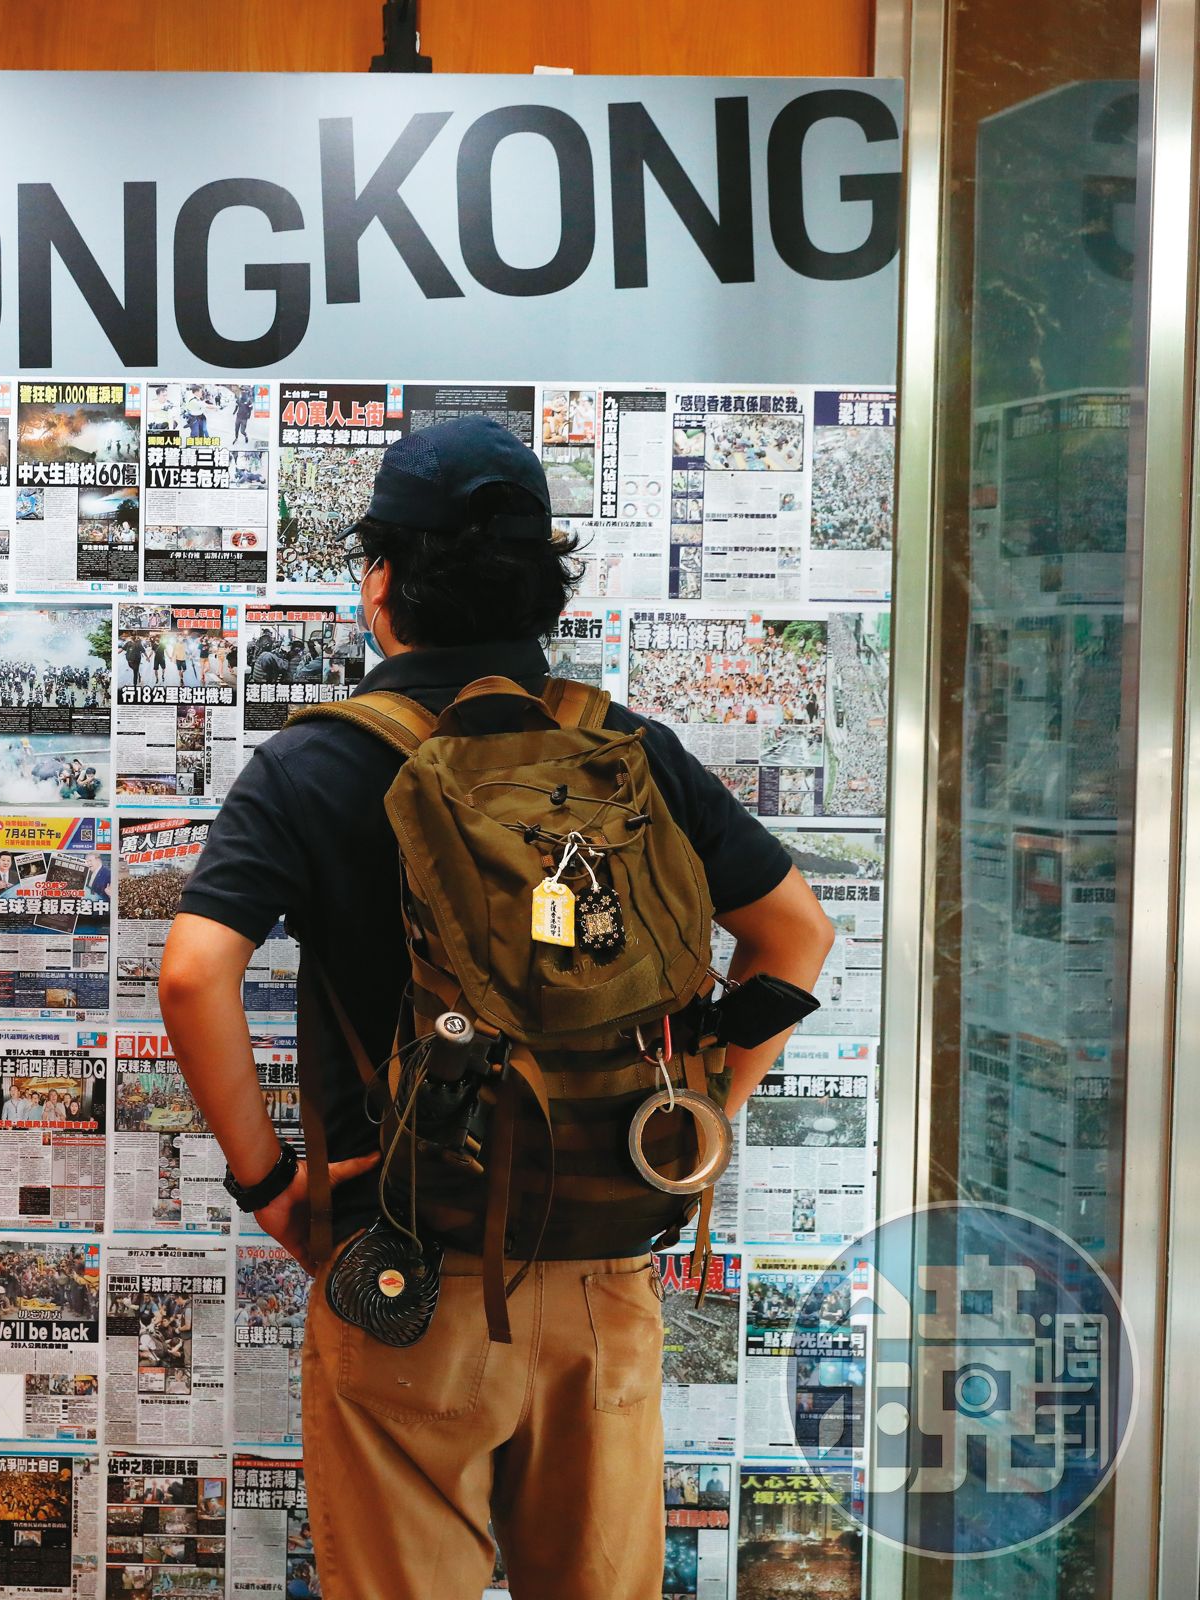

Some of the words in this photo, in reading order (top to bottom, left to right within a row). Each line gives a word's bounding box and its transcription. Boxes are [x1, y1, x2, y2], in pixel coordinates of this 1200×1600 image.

[318, 89, 900, 303] KONG
[281, 400, 385, 428] 40萬人上街
[673, 394, 805, 414] 「感覺香港真係屬於我」
[602, 396, 619, 518] 九成市民贊成佔領中環
[18, 463, 95, 486] 中大生護校
[97, 463, 138, 486] 60傷
[150, 468, 230, 489] IVE生危殆
[632, 621, 748, 651] 香港始終有你
[121, 686, 233, 705] 行18公里逃出機場
[246, 684, 355, 703] 速龍無差別毆市
[121, 824, 210, 854] 萬人圍警總
[117, 1060, 150, 1074] 反釋法
[255, 1063, 298, 1085] 誓連根
[650, 1254, 725, 1293] 人萬歲
[141, 1276, 223, 1294] 岑敖暉黃之鋒被捕
[29, 1321, 49, 1341] be
[52, 1321, 89, 1341] back
[235, 1326, 304, 1344] 區選投票率
[234, 1470, 299, 1488] 警瘋狂清場
[234, 1490, 308, 1509] 拉扯拖行學生
